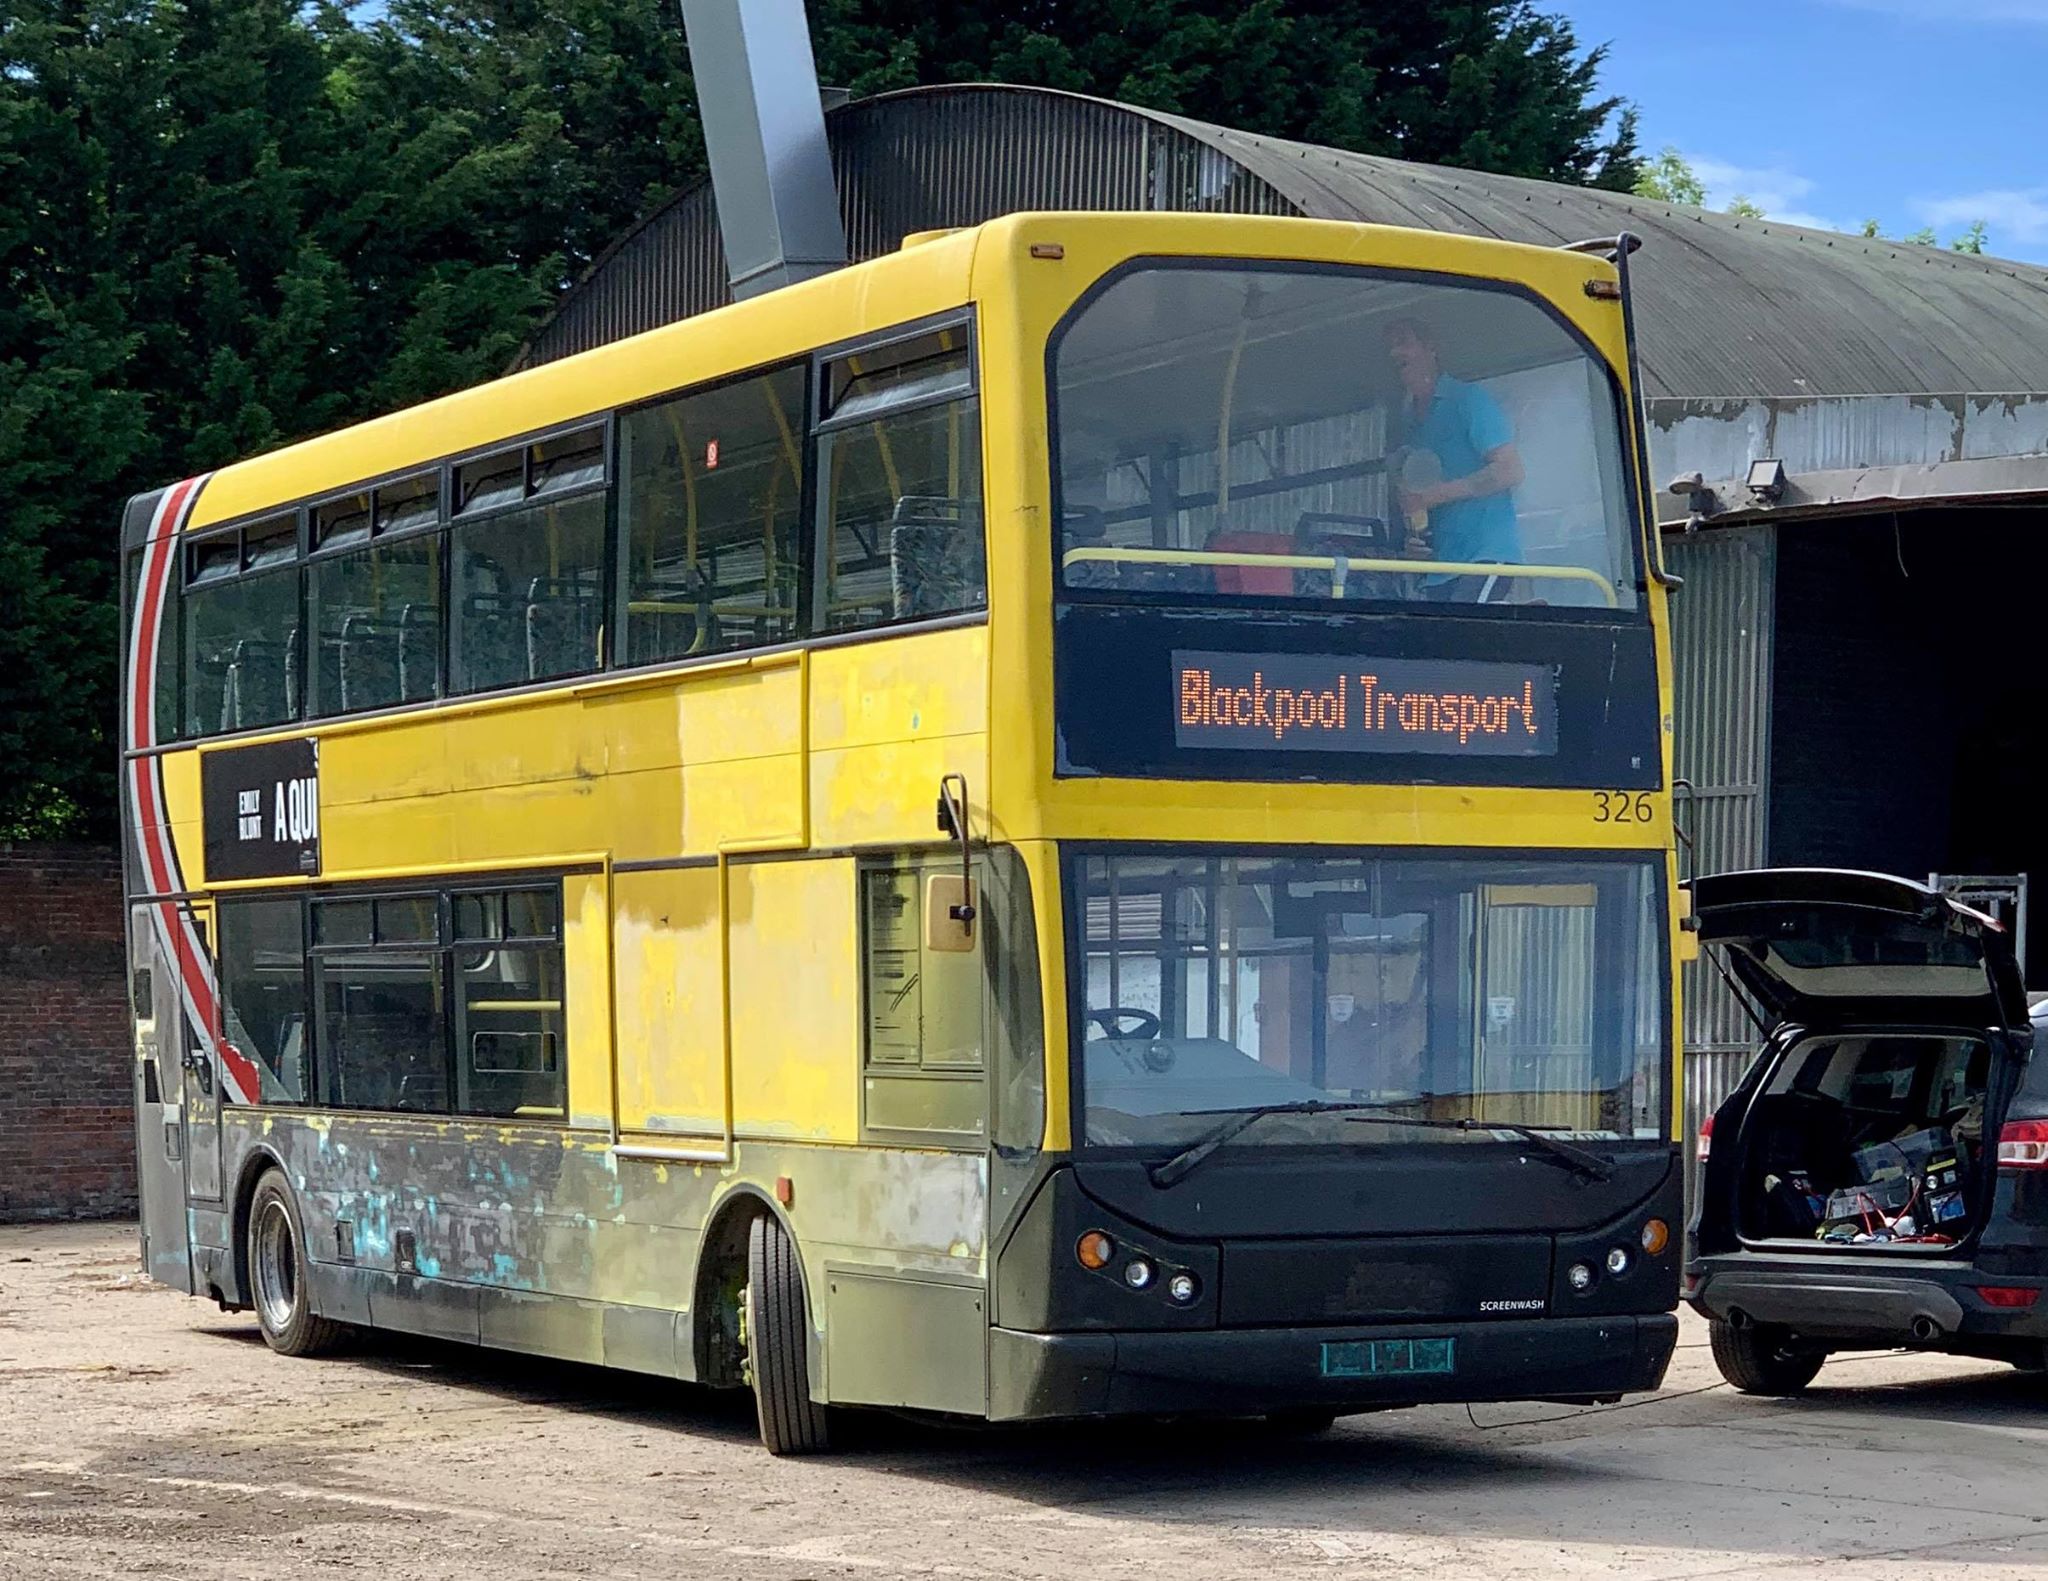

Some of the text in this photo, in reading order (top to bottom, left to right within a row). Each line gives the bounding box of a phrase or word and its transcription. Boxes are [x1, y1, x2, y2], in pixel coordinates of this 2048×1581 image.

[1181, 669, 1538, 745] Blackpool Transport
[1593, 791, 1653, 823] 326
[1480, 1299, 1545, 1311] SCREENWASH
